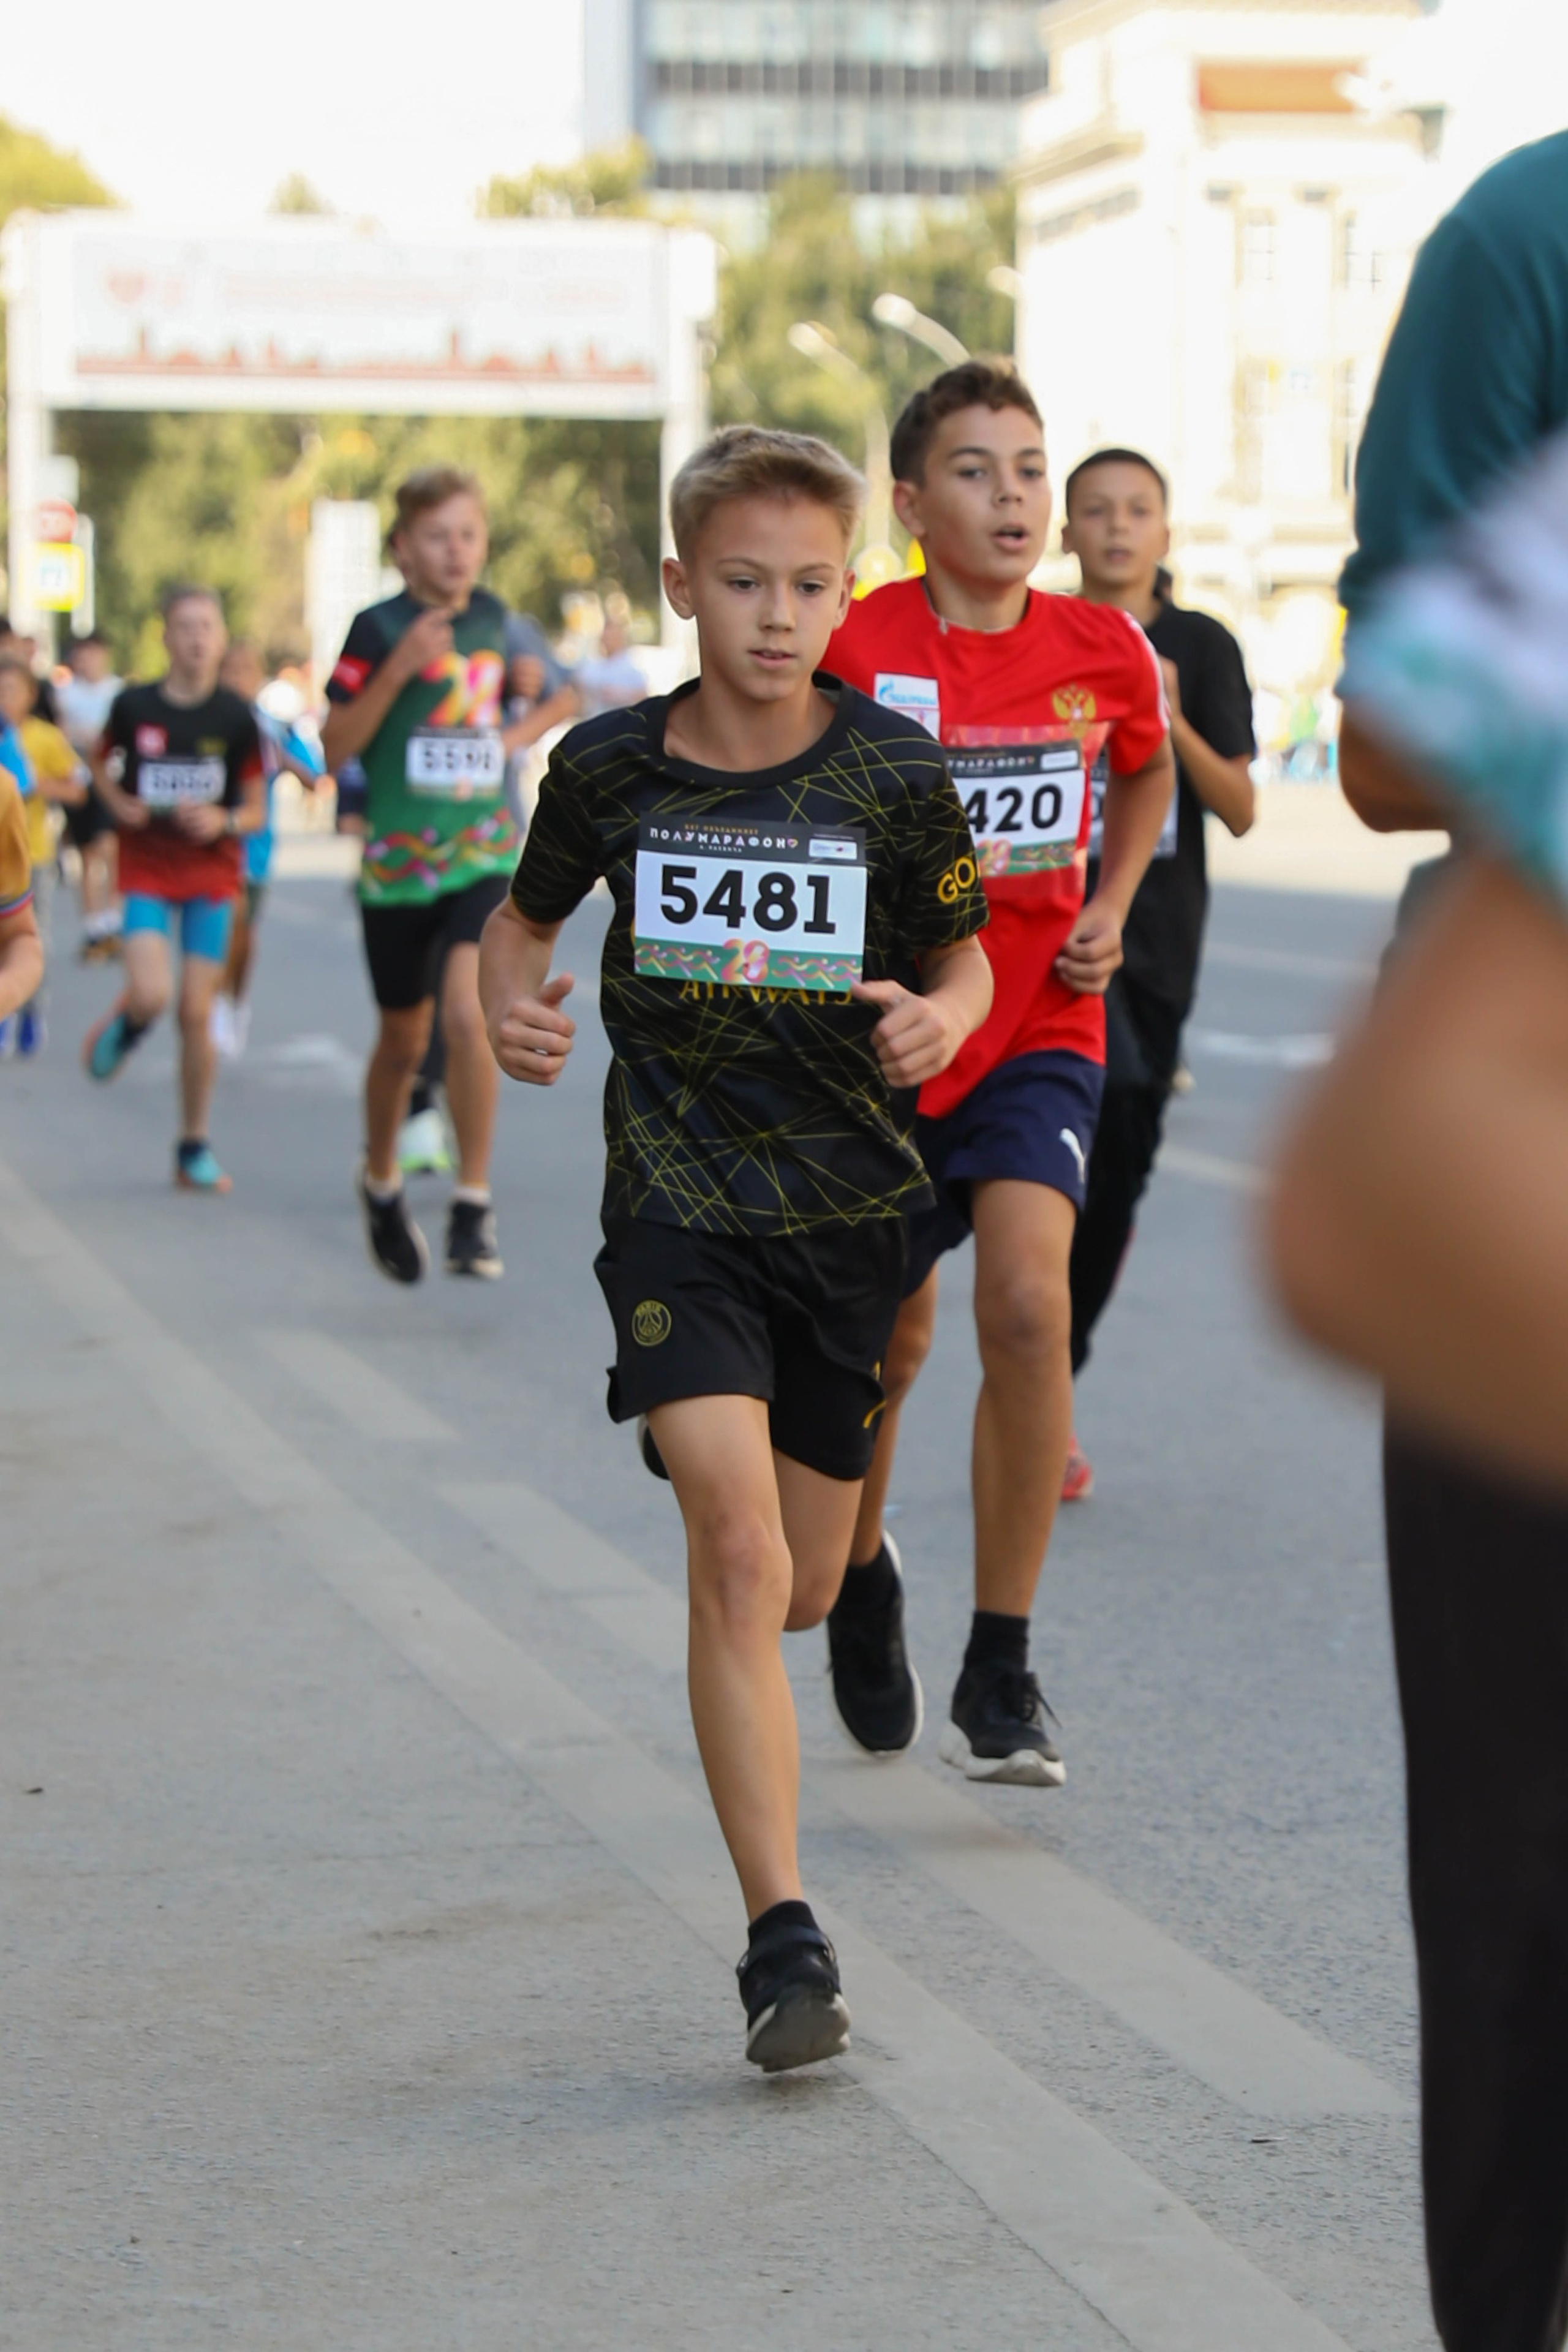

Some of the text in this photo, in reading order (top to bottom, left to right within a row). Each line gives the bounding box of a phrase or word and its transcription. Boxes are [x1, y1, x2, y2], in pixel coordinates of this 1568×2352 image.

[965, 784, 1063, 834] 420
[650, 827, 785, 849] ПОЛУМАРАФОН
[660, 864, 837, 935] 5481
